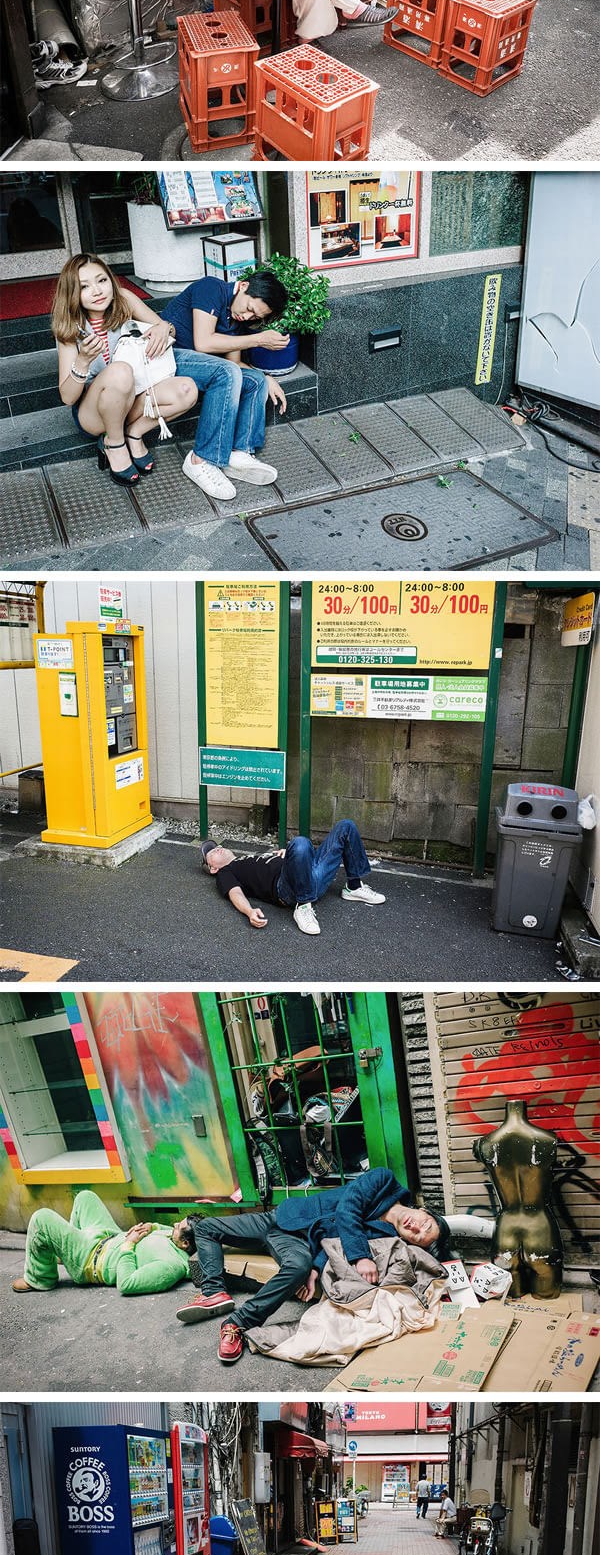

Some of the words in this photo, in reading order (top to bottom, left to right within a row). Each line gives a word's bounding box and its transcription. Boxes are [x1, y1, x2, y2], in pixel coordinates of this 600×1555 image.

[338, 655, 394, 664] 0120-325-130
[449, 696, 484, 704] careco
[521, 784, 565, 797] KIRIN
[69, 1457, 106, 1472] COFFEE
[67, 1505, 115, 1522] BOSS
